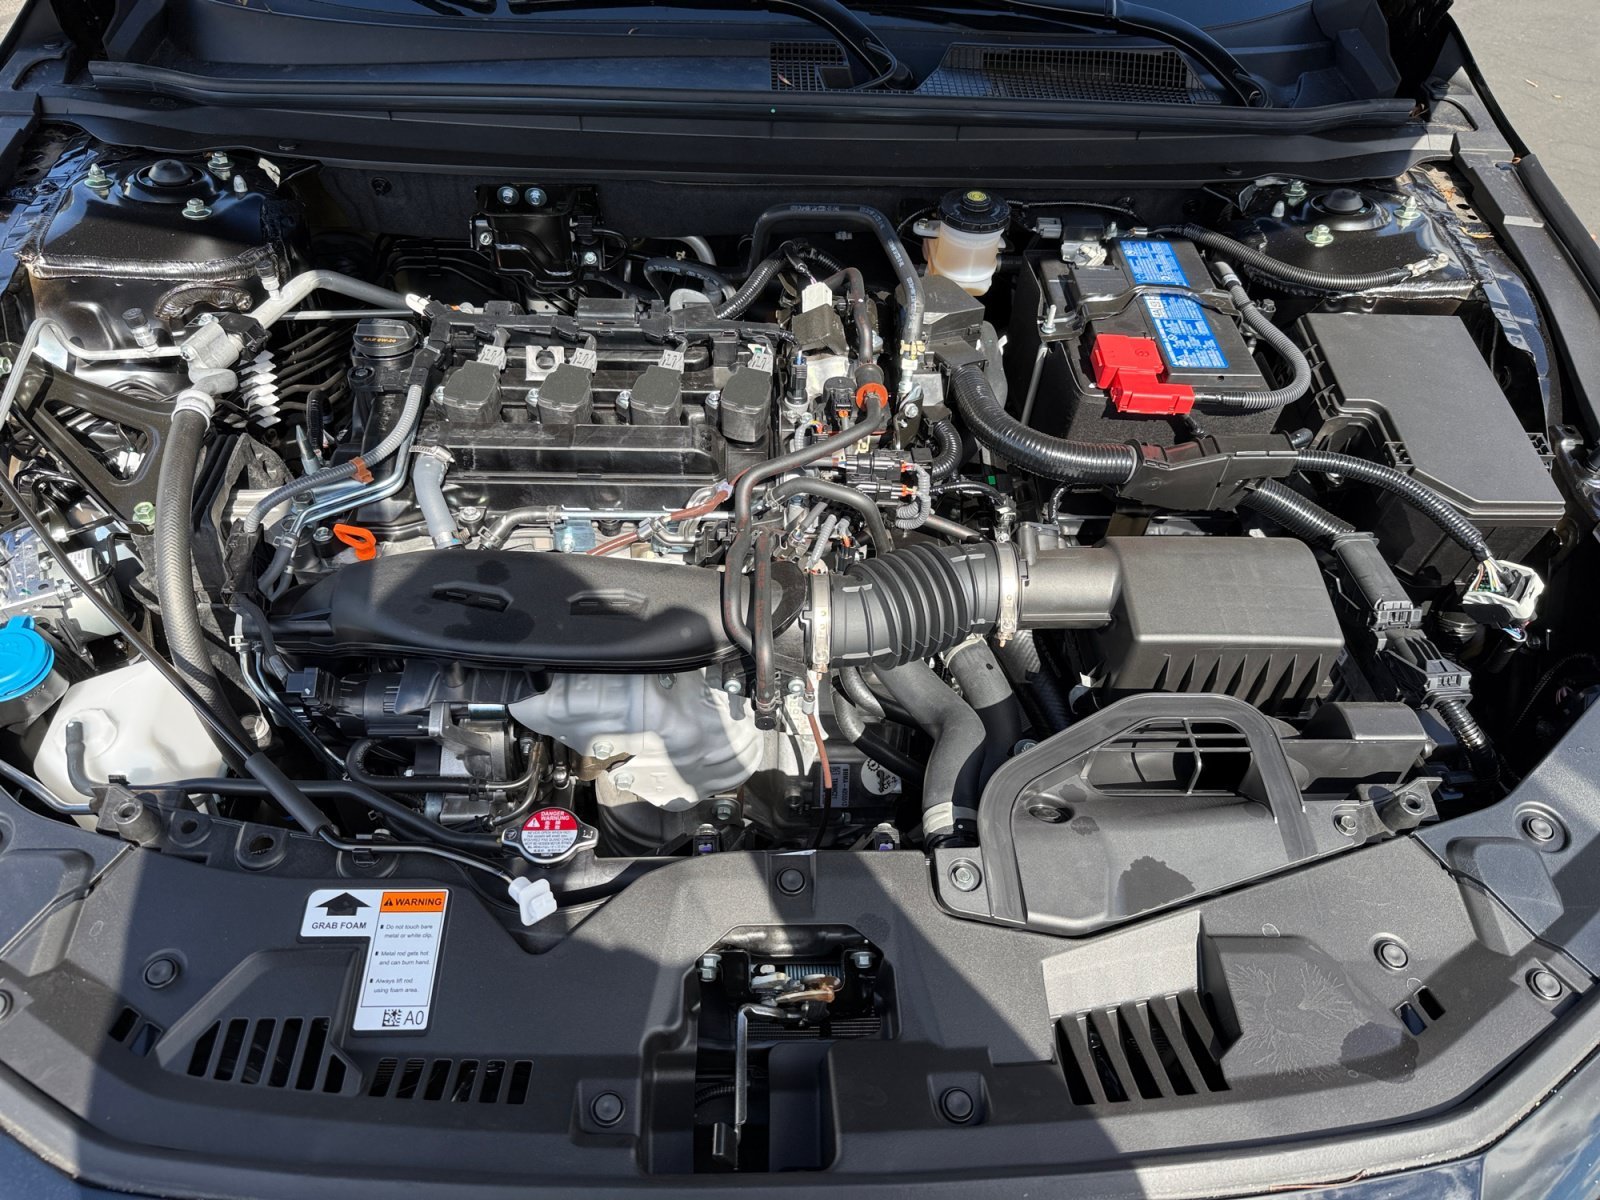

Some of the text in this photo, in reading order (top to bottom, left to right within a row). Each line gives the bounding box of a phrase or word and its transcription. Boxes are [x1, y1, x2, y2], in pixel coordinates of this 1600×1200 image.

[395, 898, 442, 907] WARNING
[311, 922, 367, 930] GRAB FOAM
[403, 1010, 424, 1025] A0
